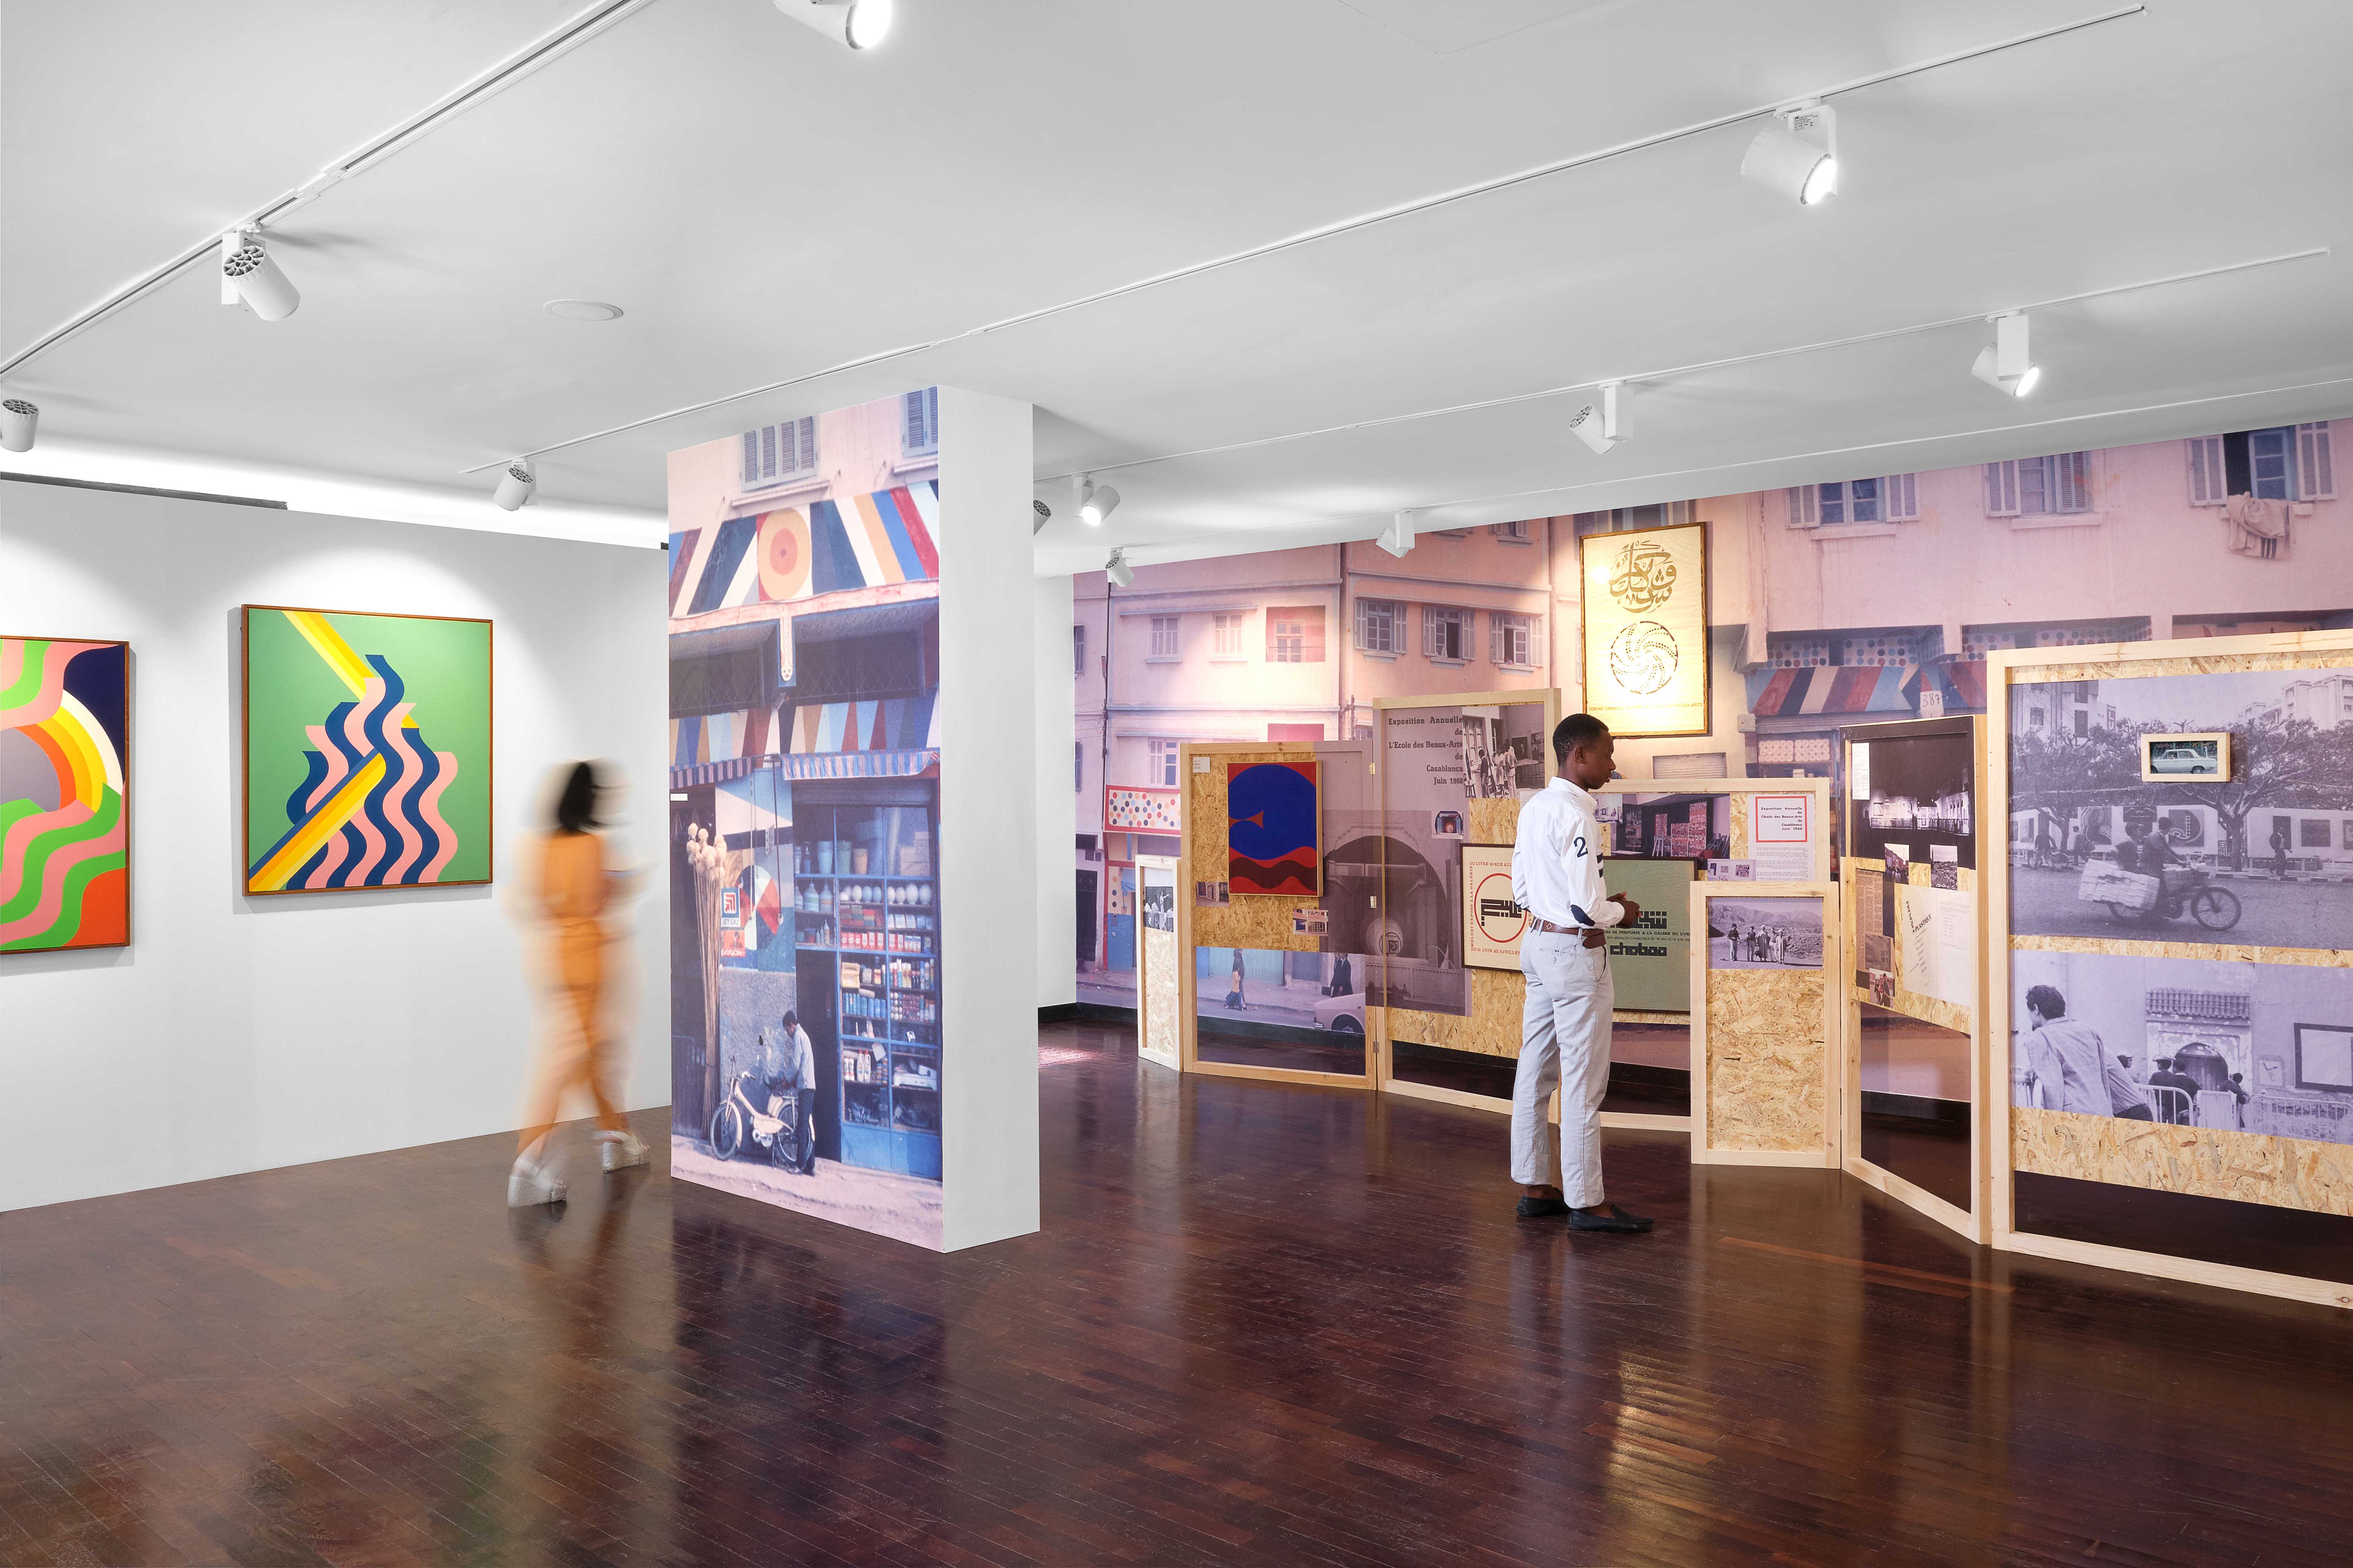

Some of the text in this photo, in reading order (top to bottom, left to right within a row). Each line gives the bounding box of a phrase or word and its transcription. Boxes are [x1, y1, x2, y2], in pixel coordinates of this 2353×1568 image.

[1922, 694, 1941, 707] 387
[1388, 717, 1425, 726] Exposition
[1434, 777, 1447, 785] Juin
[1574, 837, 1589, 858] 2
[1914, 913, 1932, 932] PLASTIQUE
